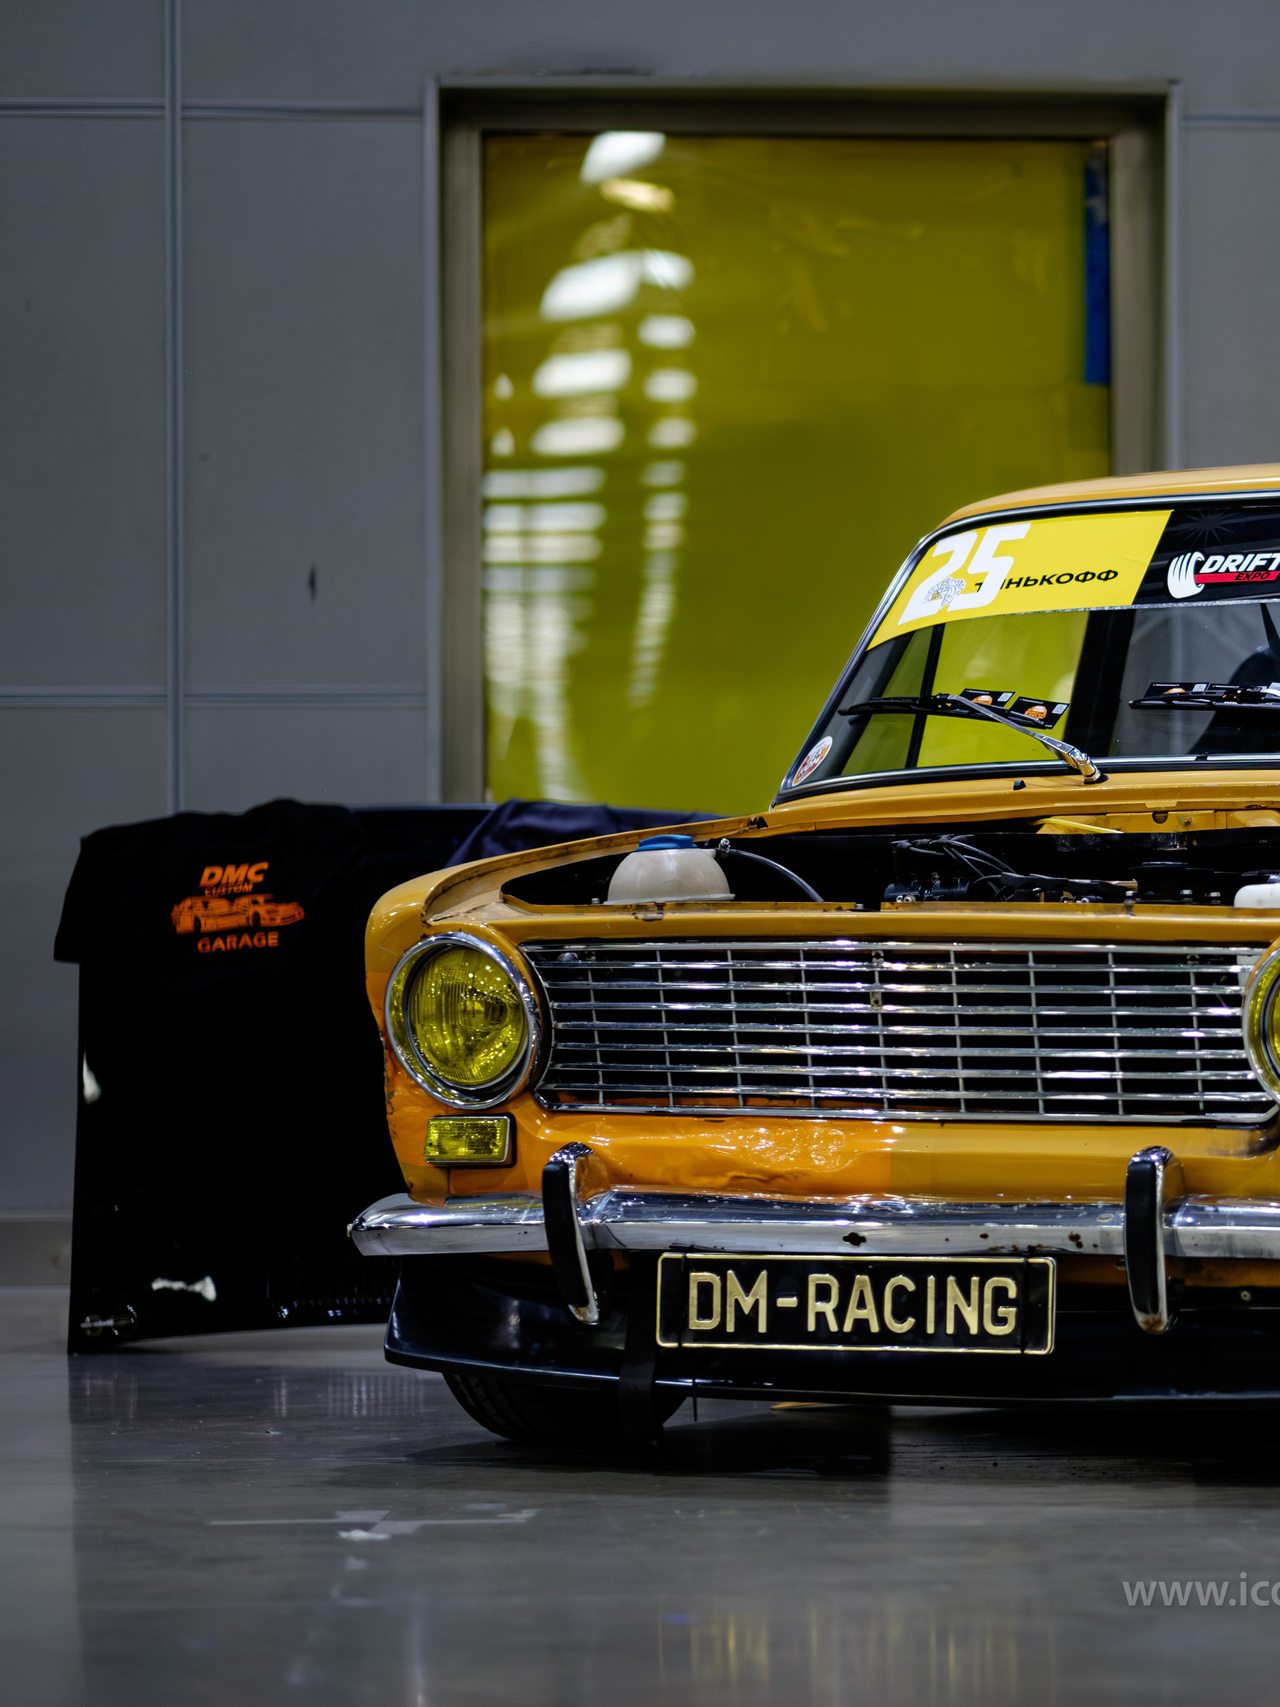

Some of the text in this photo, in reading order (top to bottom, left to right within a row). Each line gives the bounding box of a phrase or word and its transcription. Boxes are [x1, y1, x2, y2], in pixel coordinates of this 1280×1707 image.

[898, 522, 1032, 626] 25
[974, 569, 1119, 593] ТНЬКОФФ
[1234, 571, 1271, 581] EXPO
[199, 861, 269, 888] DMC
[204, 882, 254, 898] CUSTOM
[197, 931, 280, 953] GARAGE
[688, 1269, 1018, 1336] DM-RACING
